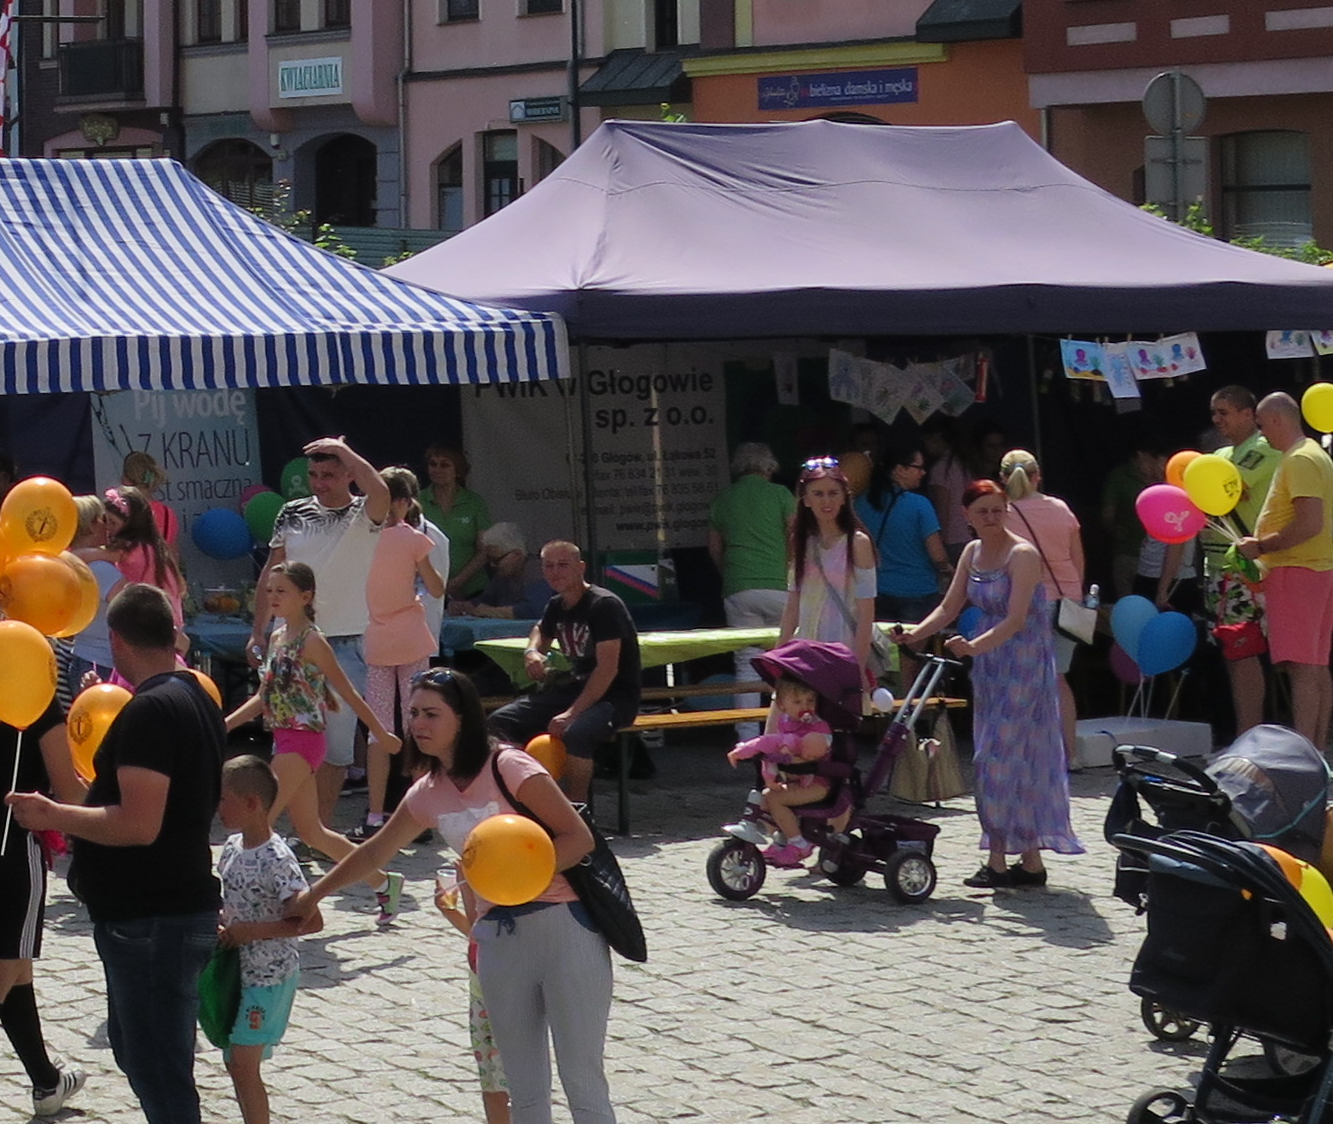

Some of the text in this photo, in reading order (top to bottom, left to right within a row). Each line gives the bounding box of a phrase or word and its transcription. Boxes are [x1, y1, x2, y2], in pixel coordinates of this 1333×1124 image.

[281, 63, 340, 91] KWIACIARNIA
[809, 83, 841, 97] bielizna
[844, 80, 877, 95] damska
[587, 368, 714, 401] Głogowie
[135, 387, 247, 427] Pij wodę
[595, 408, 634, 434] sp.
[666, 405, 714, 426] o.o.
[162, 428, 251, 469] KRANU
